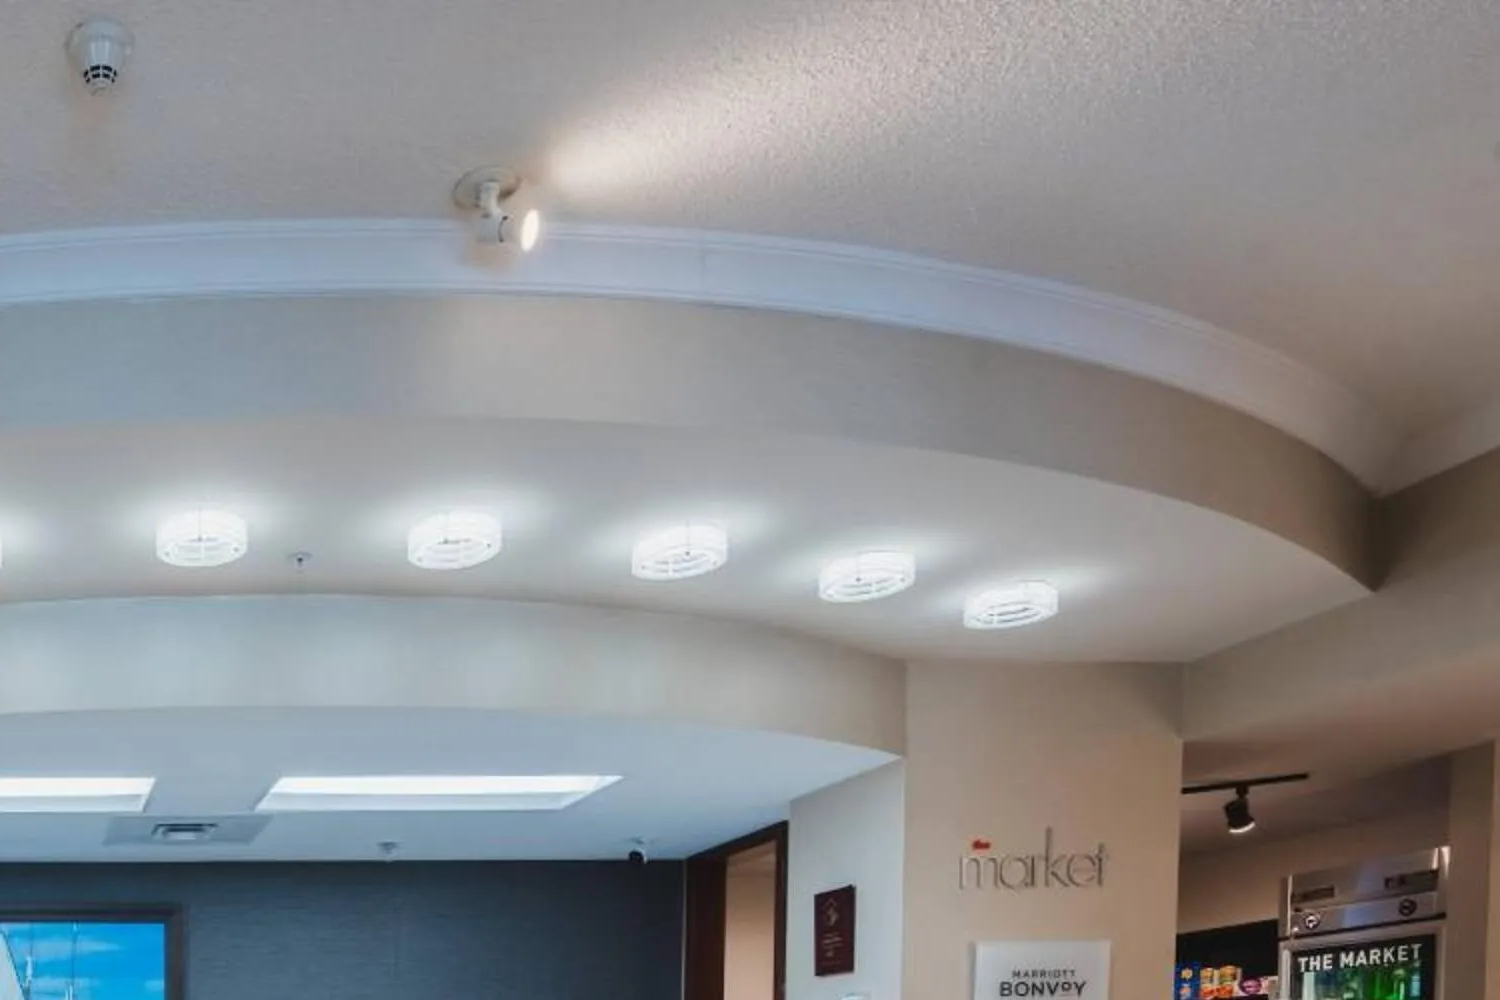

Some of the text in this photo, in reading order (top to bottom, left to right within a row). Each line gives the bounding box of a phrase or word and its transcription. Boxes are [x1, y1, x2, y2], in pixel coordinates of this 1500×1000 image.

[959, 826, 1108, 889] market
[1298, 943, 1422, 973] THE MARKET
[1011, 969, 1076, 979] MARRIOTT
[999, 981, 1086, 998] BONVOY
